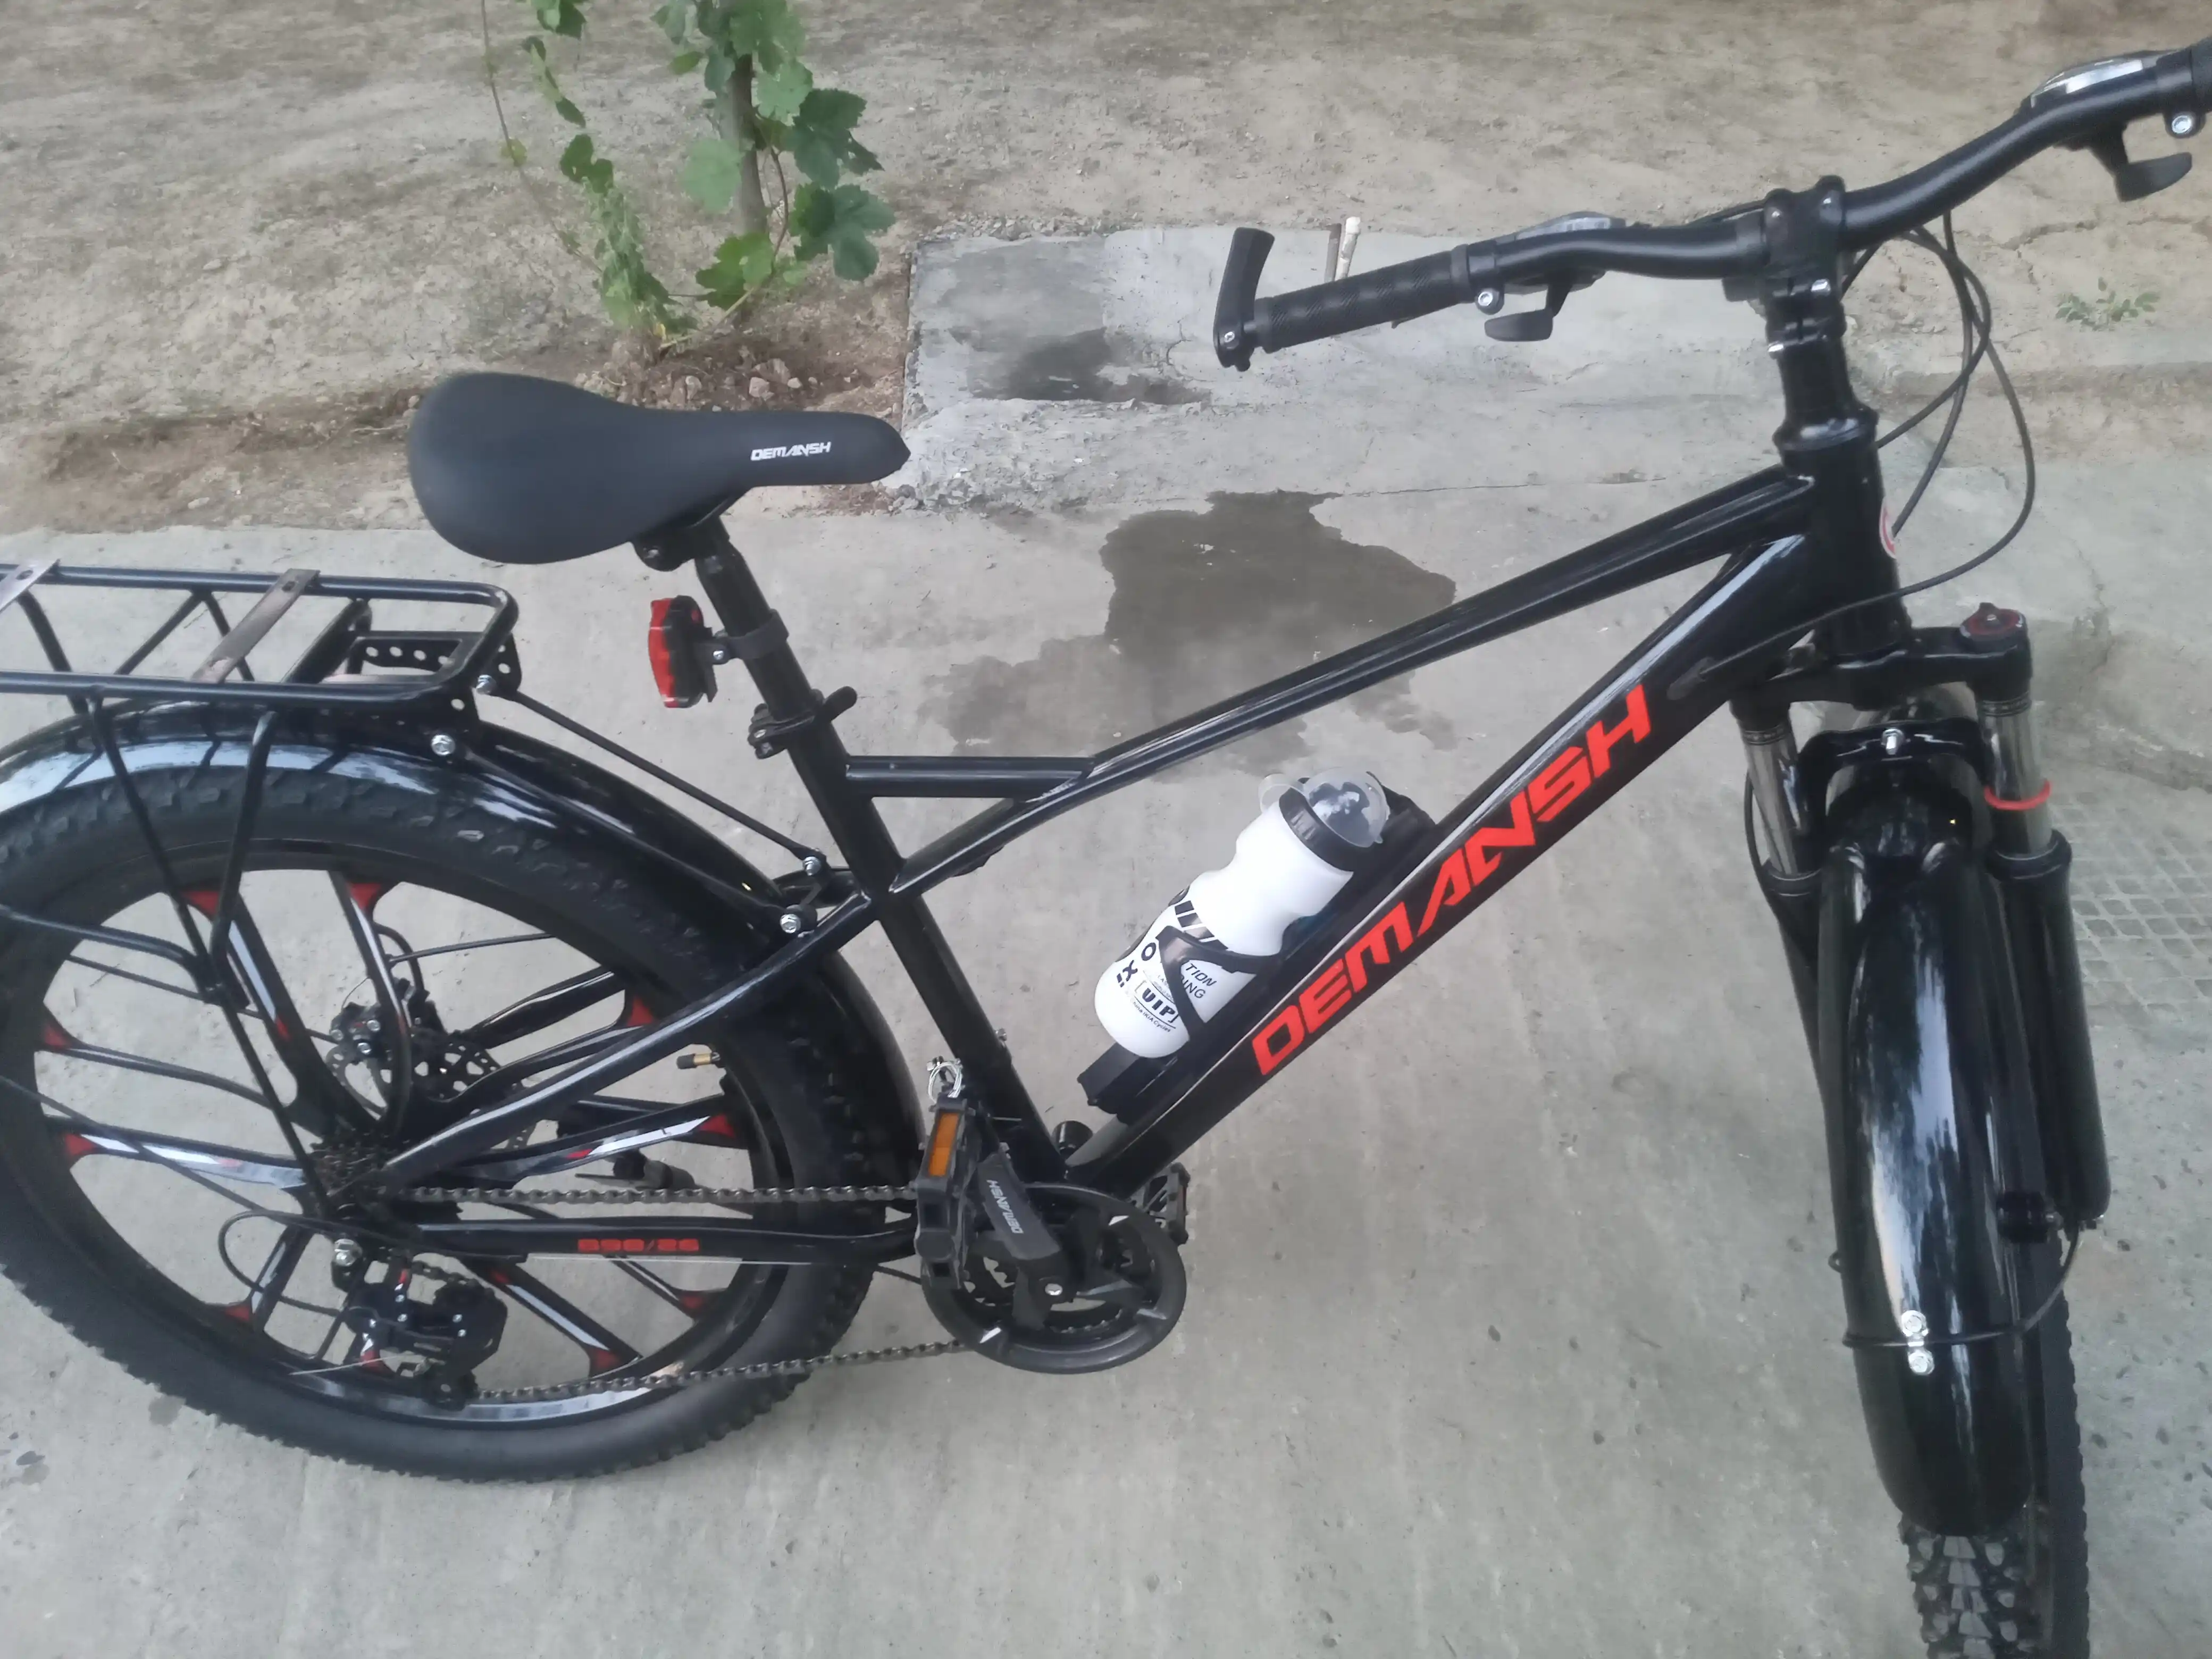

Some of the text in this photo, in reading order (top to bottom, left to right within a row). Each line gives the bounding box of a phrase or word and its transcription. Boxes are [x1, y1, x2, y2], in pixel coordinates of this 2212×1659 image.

[750, 441, 832, 461] DEMANSH
[1251, 683, 1652, 1076] DEMANSH
[1185, 963, 1217, 986] TION
